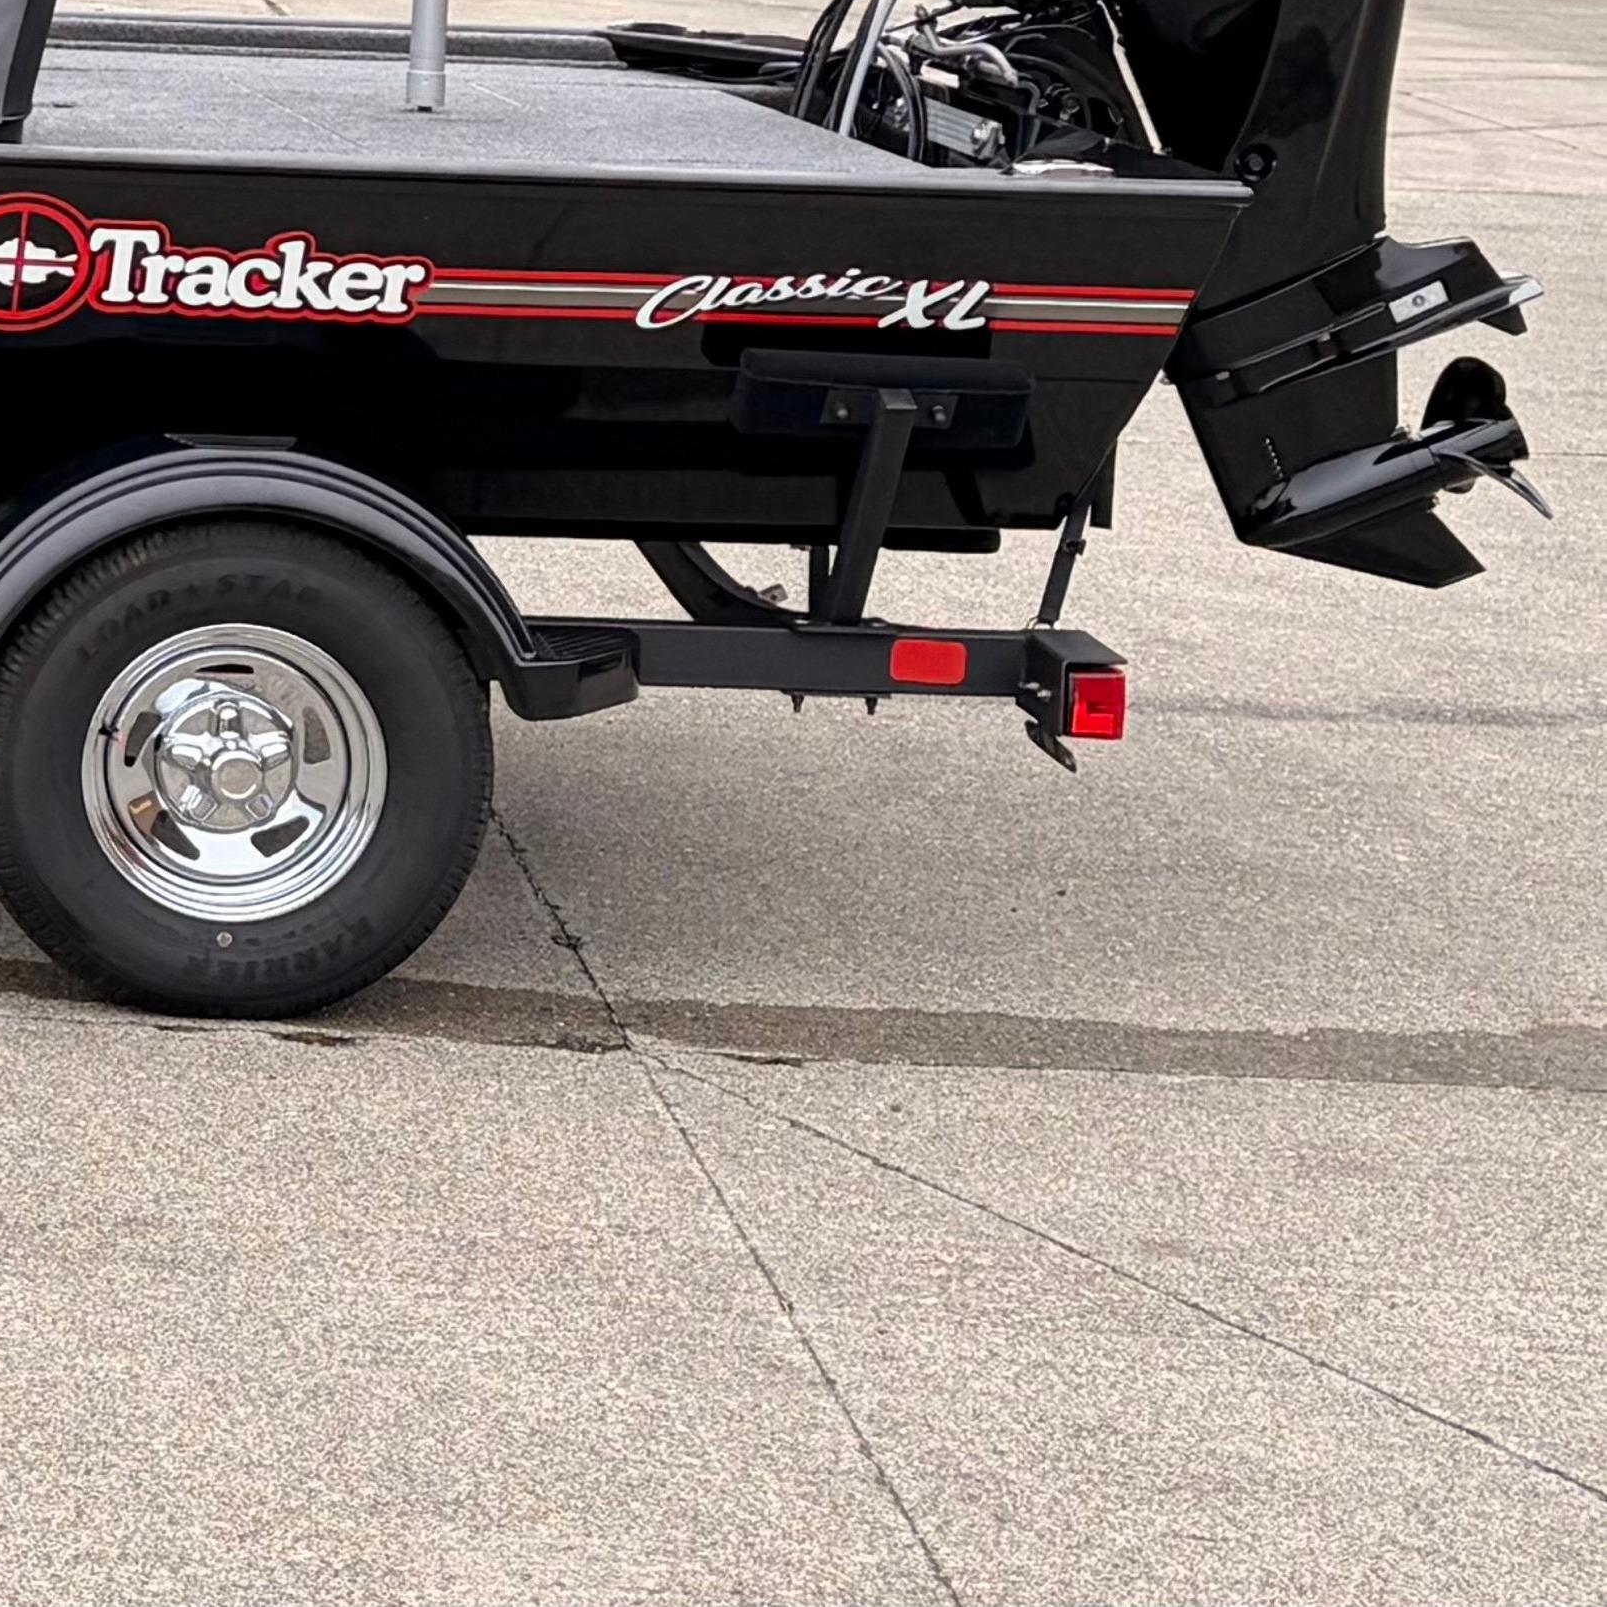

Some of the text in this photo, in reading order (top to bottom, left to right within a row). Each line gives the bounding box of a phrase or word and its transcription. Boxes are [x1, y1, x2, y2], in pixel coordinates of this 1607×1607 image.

[90, 228, 427, 314] Tracker
[635, 268, 990, 330] Classic XL
[76, 588, 170, 665] LOAD
